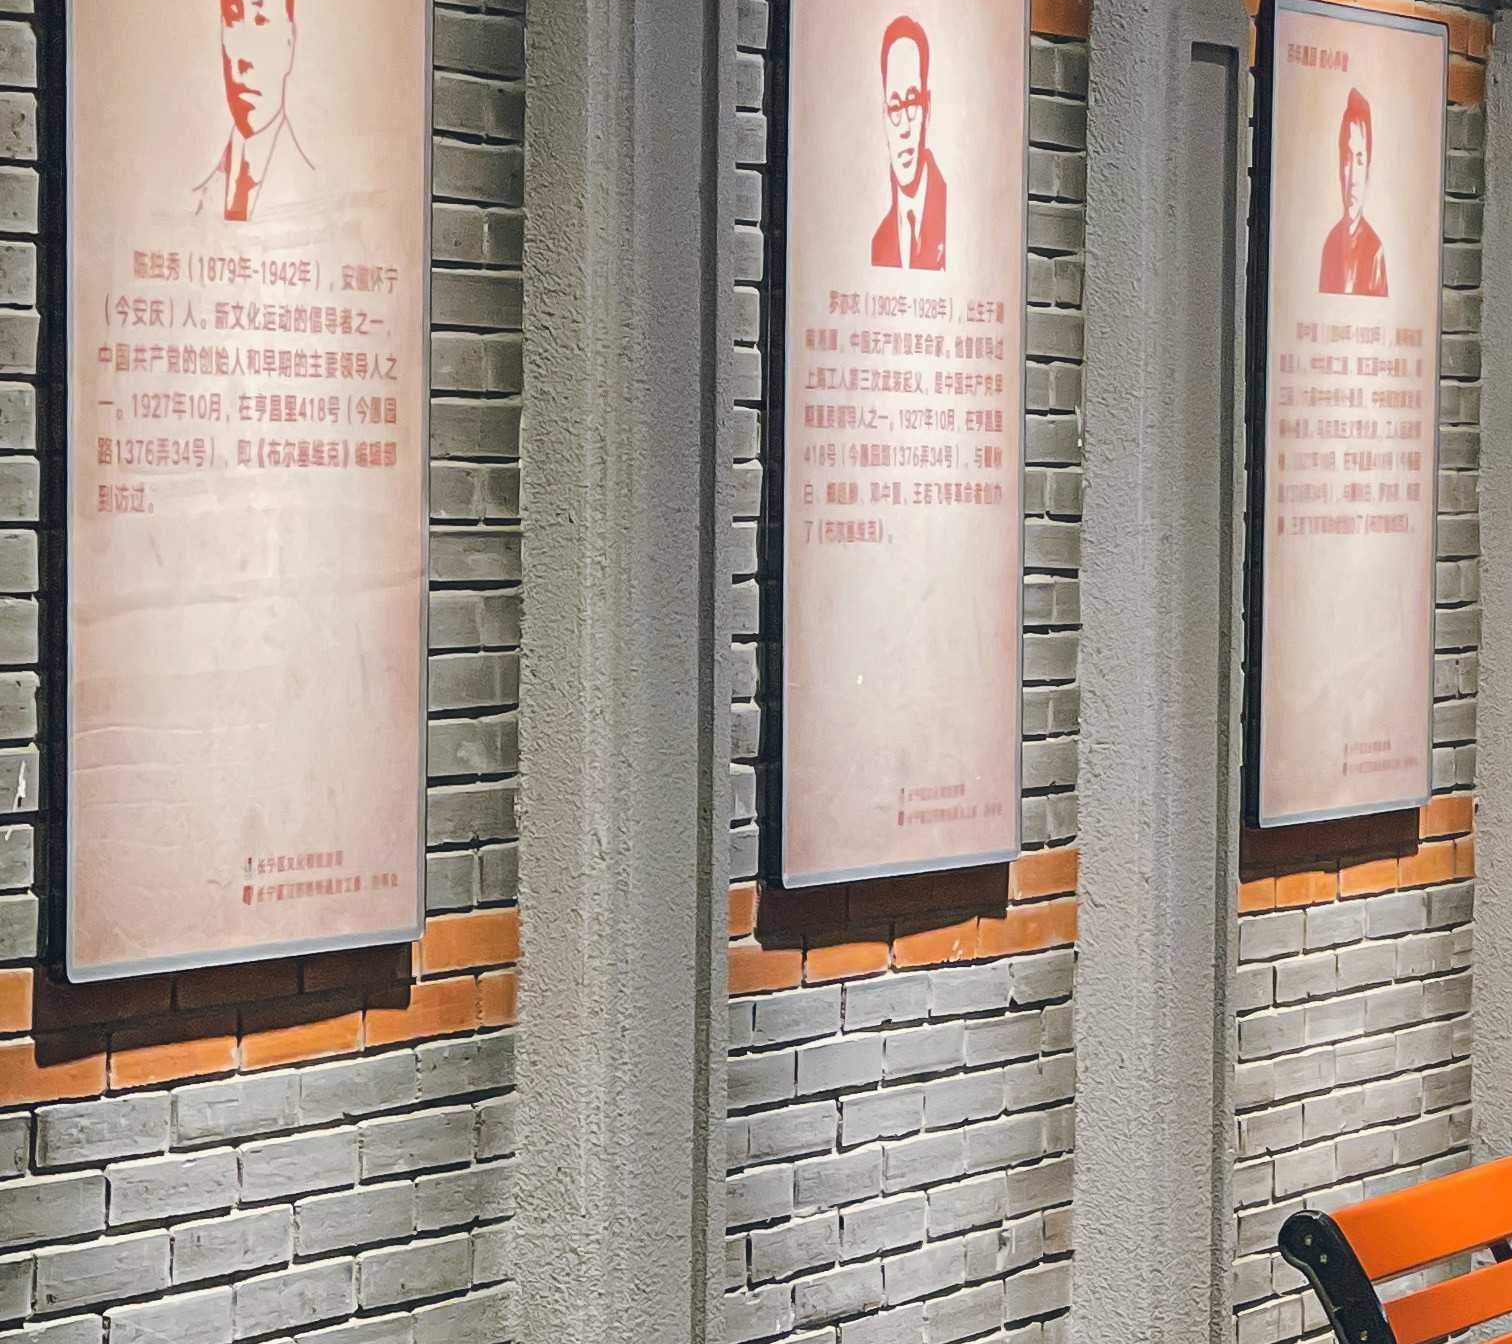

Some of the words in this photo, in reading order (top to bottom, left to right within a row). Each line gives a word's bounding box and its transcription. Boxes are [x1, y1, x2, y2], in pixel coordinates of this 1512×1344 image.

[98, 343, 399, 382] 中国共产党的创始人和早期的主要领导人之
